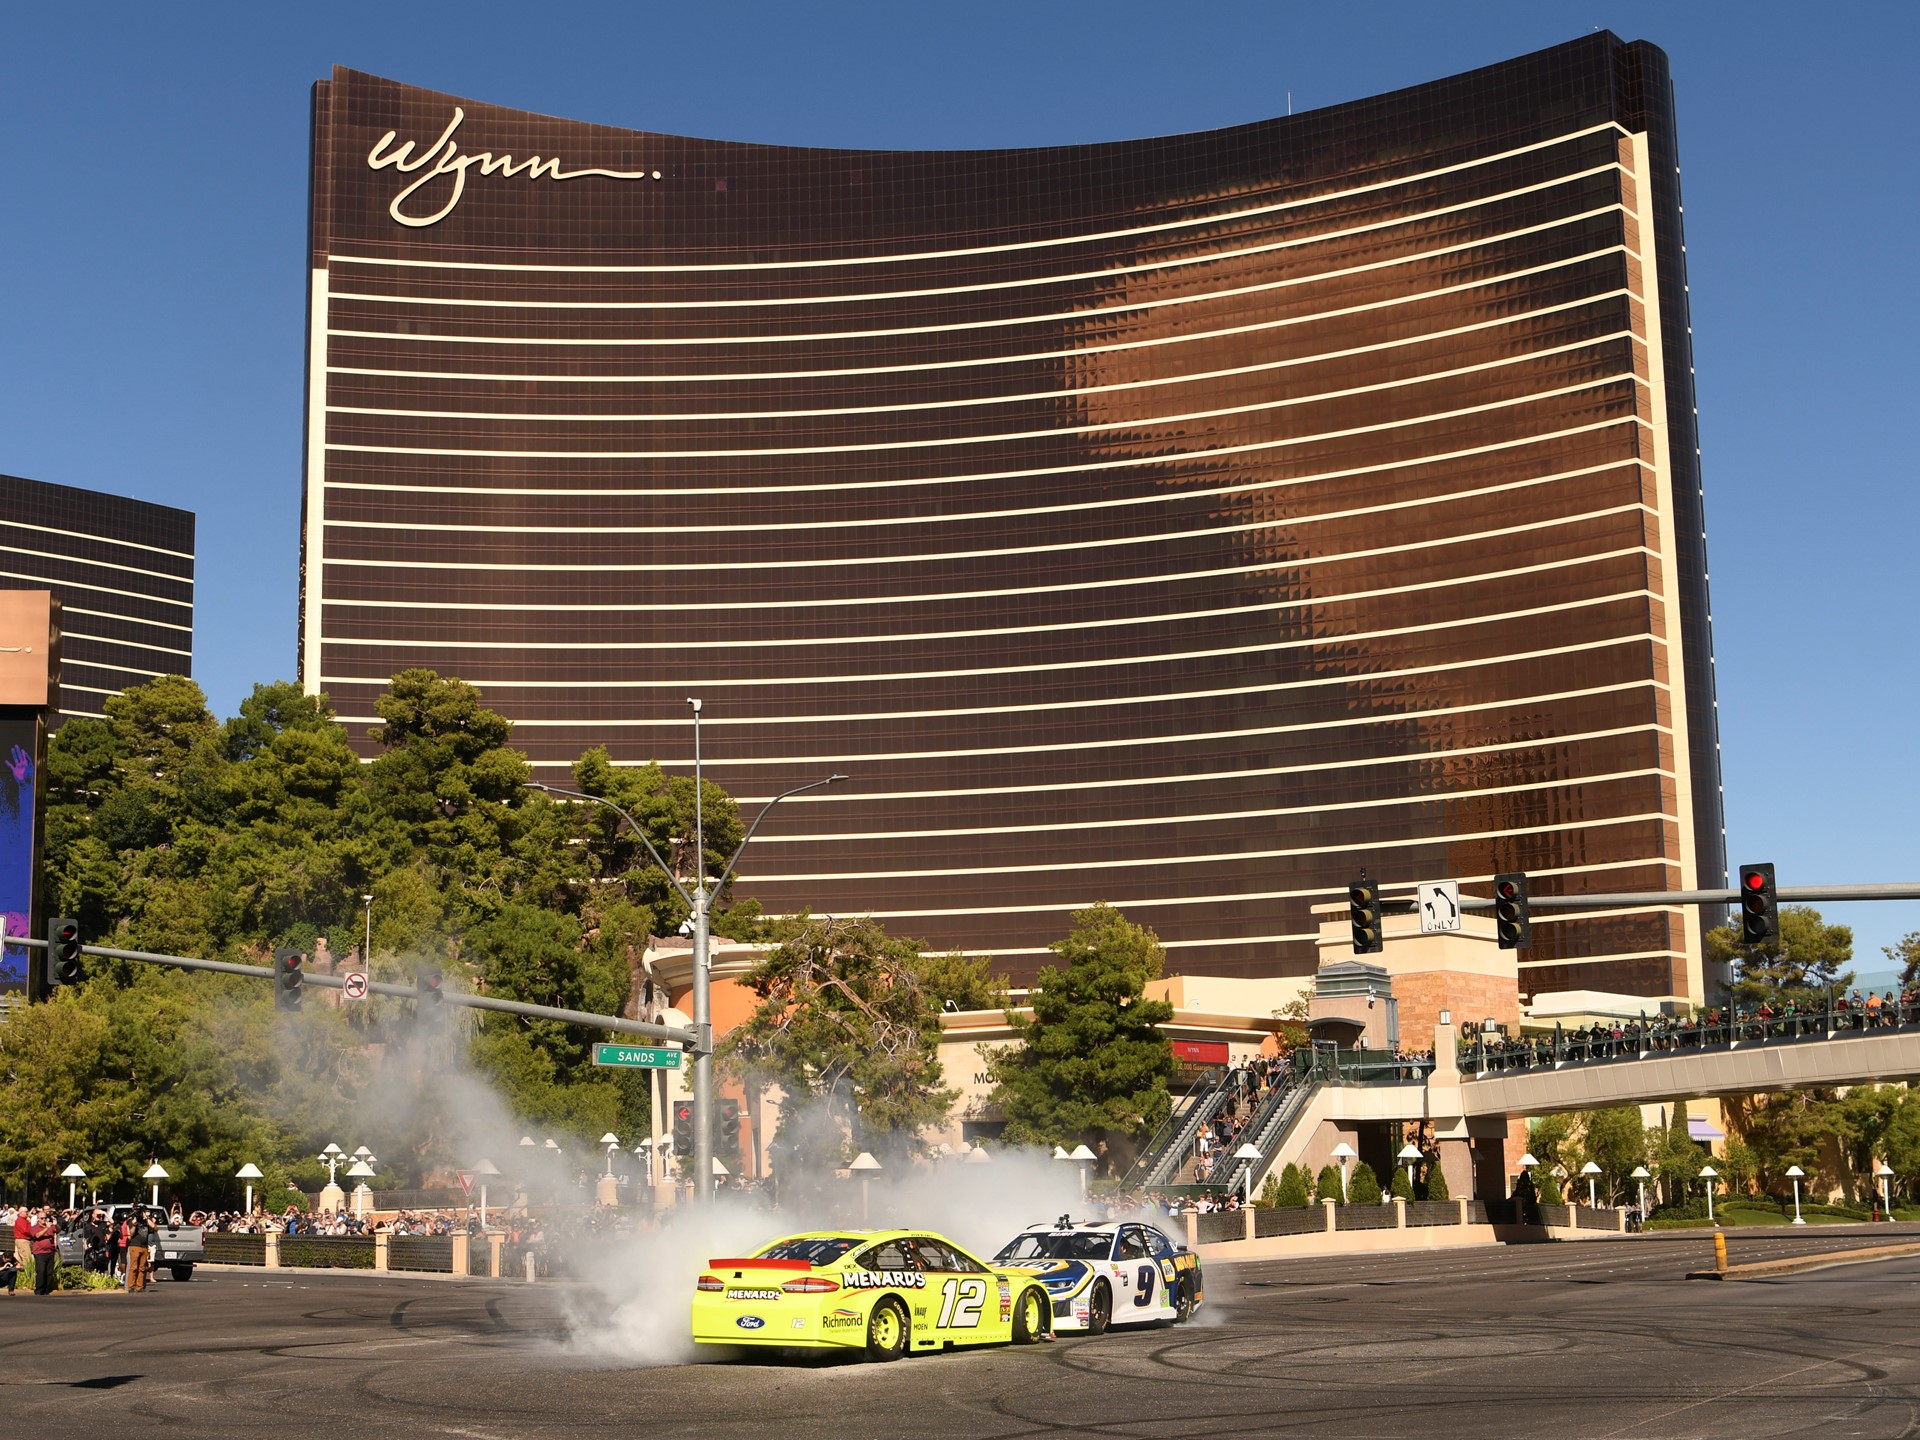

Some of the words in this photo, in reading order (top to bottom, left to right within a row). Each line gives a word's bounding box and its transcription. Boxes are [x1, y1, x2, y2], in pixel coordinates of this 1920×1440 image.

[1427, 920, 1454, 931] ONLY
[1461, 1021, 1508, 1040] CHEL
[618, 1051, 655, 1063] SANDS
[842, 1271, 926, 1288] MENARDS
[1133, 1265, 1156, 1308] 9
[727, 1288, 782, 1300] MENARDS
[936, 1278, 987, 1329] 12
[740, 1317, 761, 1328] Ford
[791, 1318, 805, 1328] 12
[823, 1313, 863, 1328] Richmond
